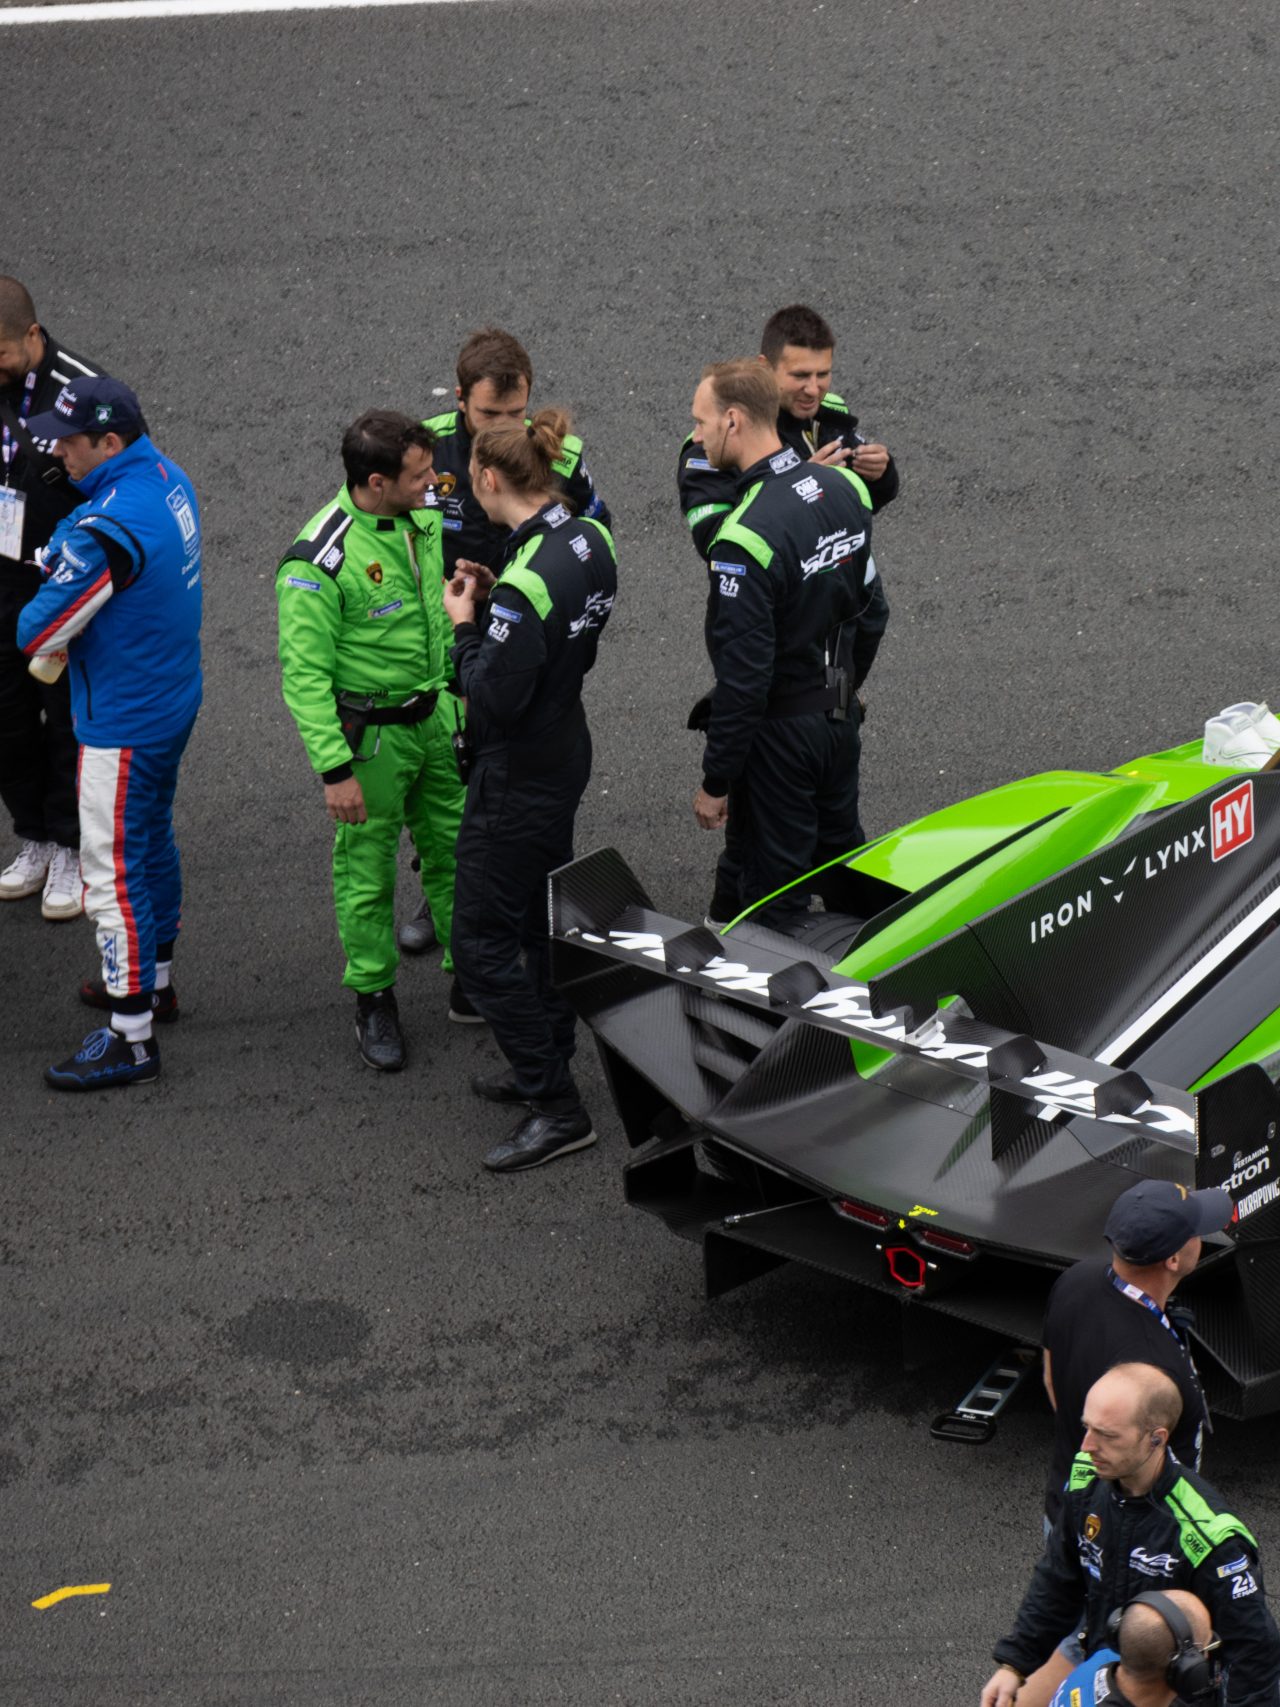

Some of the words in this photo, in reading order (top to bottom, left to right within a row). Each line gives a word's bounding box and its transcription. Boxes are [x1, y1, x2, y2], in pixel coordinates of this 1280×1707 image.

[796, 477, 819, 496] OMP
[1214, 792, 1250, 850] HY
[1030, 890, 1092, 944] IRON
[1145, 825, 1206, 880] LYNX
[1234, 1145, 1269, 1170] PERTAMINA
[1219, 1156, 1270, 1194] stron
[1184, 1533, 1204, 1553] OMP
